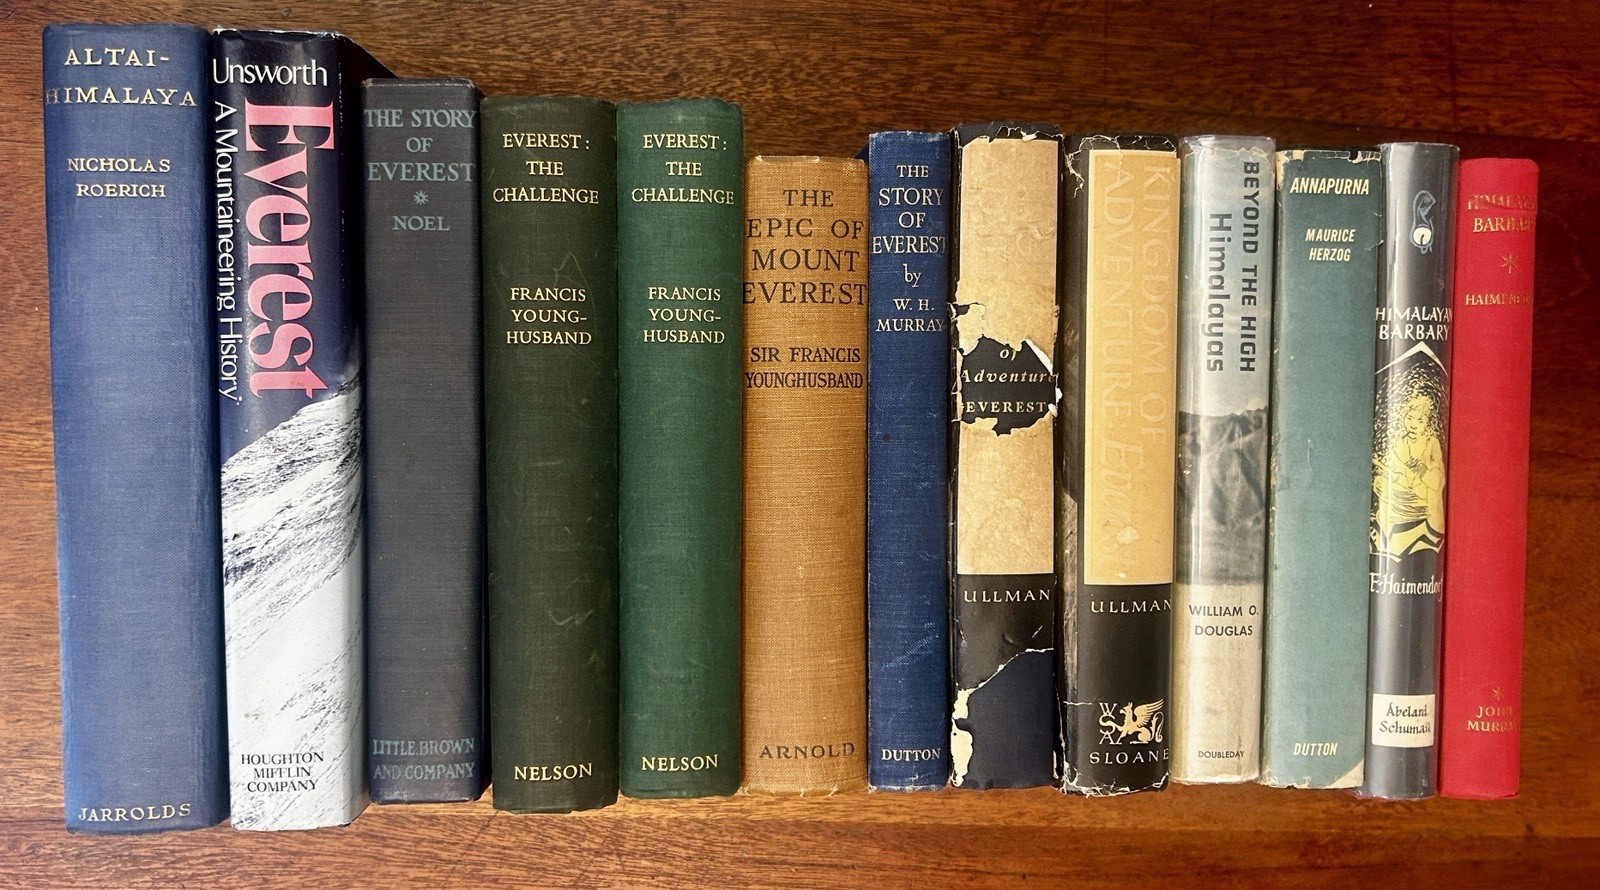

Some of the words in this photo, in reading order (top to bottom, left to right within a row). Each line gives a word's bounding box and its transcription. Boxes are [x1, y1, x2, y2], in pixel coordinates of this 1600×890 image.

[65, 47, 170, 67] ALTAI-
[212, 57, 328, 87] Unsworth
[45, 86, 198, 107] HIMALAYA
[215, 101, 237, 121] A
[364, 109, 403, 128] THE
[411, 109, 477, 128] STORY
[406, 137, 434, 153] OF
[67, 157, 171, 173] NICHOLAS
[367, 162, 476, 182] EVEREST
[526, 161, 564, 176] THE
[665, 161, 703, 177] THE
[896, 165, 930, 178] THE
[76, 184, 166, 198] ROERICH
[1290, 177, 1370, 195] ANNAPURNA
[492, 187, 599, 204] CHALLENGE
[631, 187, 735, 205] CHALLENGE
[783, 189, 834, 208] THE
[878, 187, 944, 207] STORY
[215, 130, 242, 311] Mountaineering
[392, 215, 450, 231] NOEL
[898, 211, 927, 229] OF
[747, 218, 814, 238] EPIC
[831, 219, 865, 240] OF
[1305, 228, 1356, 243] MAURICE
[243, 97, 335, 399] Everest
[872, 235, 946, 255] EVEREST
[751, 249, 861, 272] MOUNT
[1309, 247, 1351, 262] HERZOG
[902, 263, 922, 288] by
[1141, 164, 1174, 374] KINGDOM
[742, 281, 868, 306] EVEREST
[1201, 213, 1233, 372] Himalayas
[1241, 264, 1258, 306] THE
[510, 287, 586, 302] FRANCIS
[648, 287, 721, 301] FRANCIS
[893, 298, 913, 311] W.
[918, 298, 935, 311] H.
[511, 309, 587, 323] YOUNG-
[649, 308, 722, 323] YOUNG-
[875, 318, 945, 332] MURRAY
[1379, 323, 1449, 341] BARBARY
[506, 330, 592, 345] HUSBAND
[643, 329, 725, 344] HUSBAND
[1239, 316, 1257, 372] HIGH
[750, 347, 780, 363] SIR
[791, 347, 861, 364] FRANCIS
[744, 371, 864, 389] YOUNGHUSBAND
[965, 401, 1046, 413] EVEREST
[1138, 391, 1168, 446] OF
[963, 588, 1050, 604] ULLMAN
[1091, 599, 1172, 613] ULLMAN
[1188, 604, 1244, 618] WILLIAM
[1248, 604, 1260, 617] O.
[1194, 625, 1254, 637] DOUGLAS
[759, 741, 857, 760] ARNOLD
[881, 746, 941, 761] DUTTON
[1089, 749, 1170, 765] SLOANE
[1197, 750, 1245, 760] DOUBLEDAY
[1293, 742, 1338, 757] DUTTON
[241, 751, 324, 766] HOUGHTON
[641, 754, 719, 772] NELSON
[253, 766, 312, 779] MIFFLIN
[373, 764, 403, 780] AND
[404, 762, 476, 780] COMPANY
[513, 762, 593, 782] NELSON
[247, 779, 319, 793] COMPANY
[78, 803, 191, 822] JARROLDS
